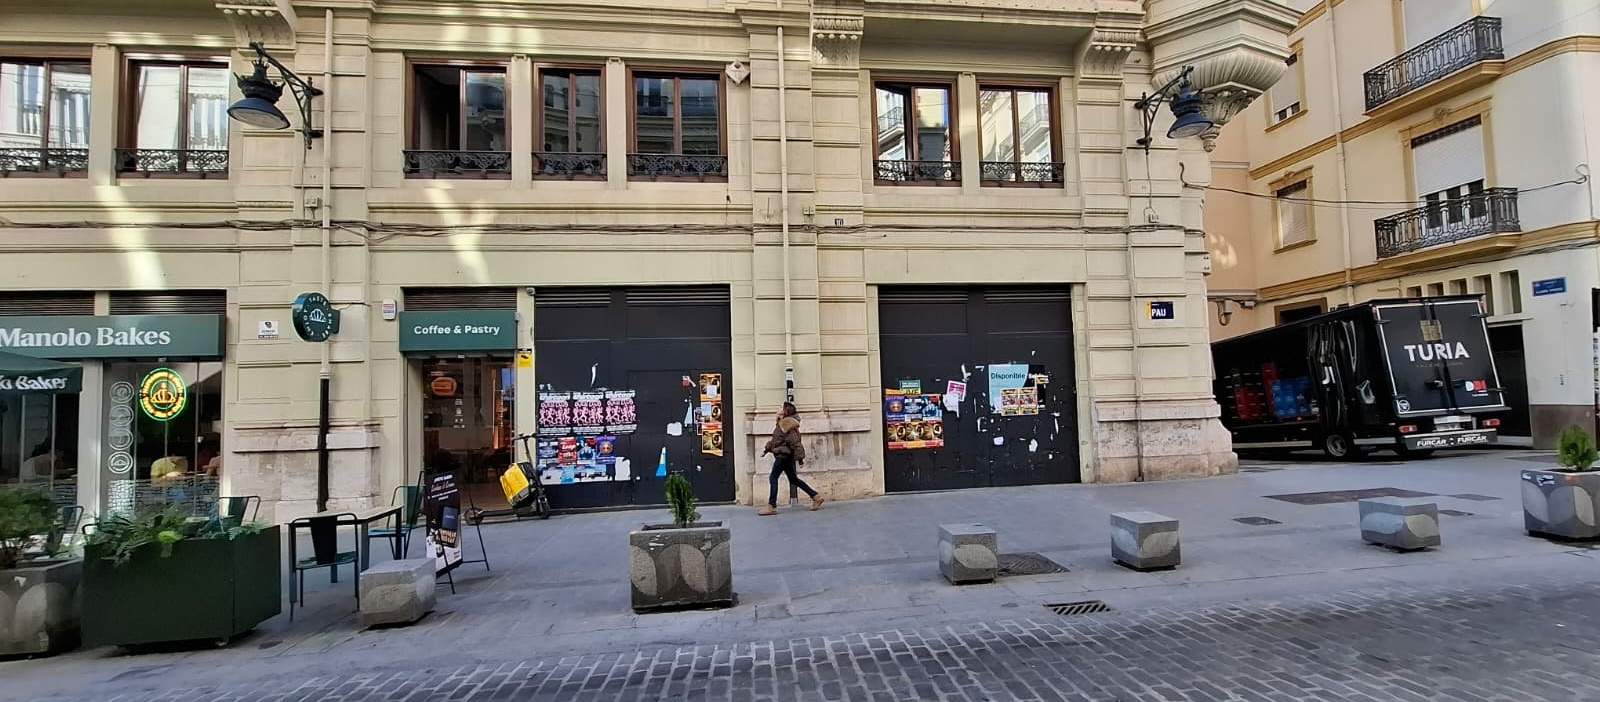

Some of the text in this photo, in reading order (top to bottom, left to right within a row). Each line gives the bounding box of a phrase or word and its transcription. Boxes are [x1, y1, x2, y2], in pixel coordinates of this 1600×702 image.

[1151, 308, 1167, 317] PAU
[413, 325, 500, 336] Coffee & Pastry
[0, 327, 171, 347] Manolo Bakes
[1403, 341, 1470, 362] TURIA
[990, 372, 1026, 380] Disponible
[1416, 439, 1448, 447] FURCAR
[1457, 435, 1488, 444] FURCAR
